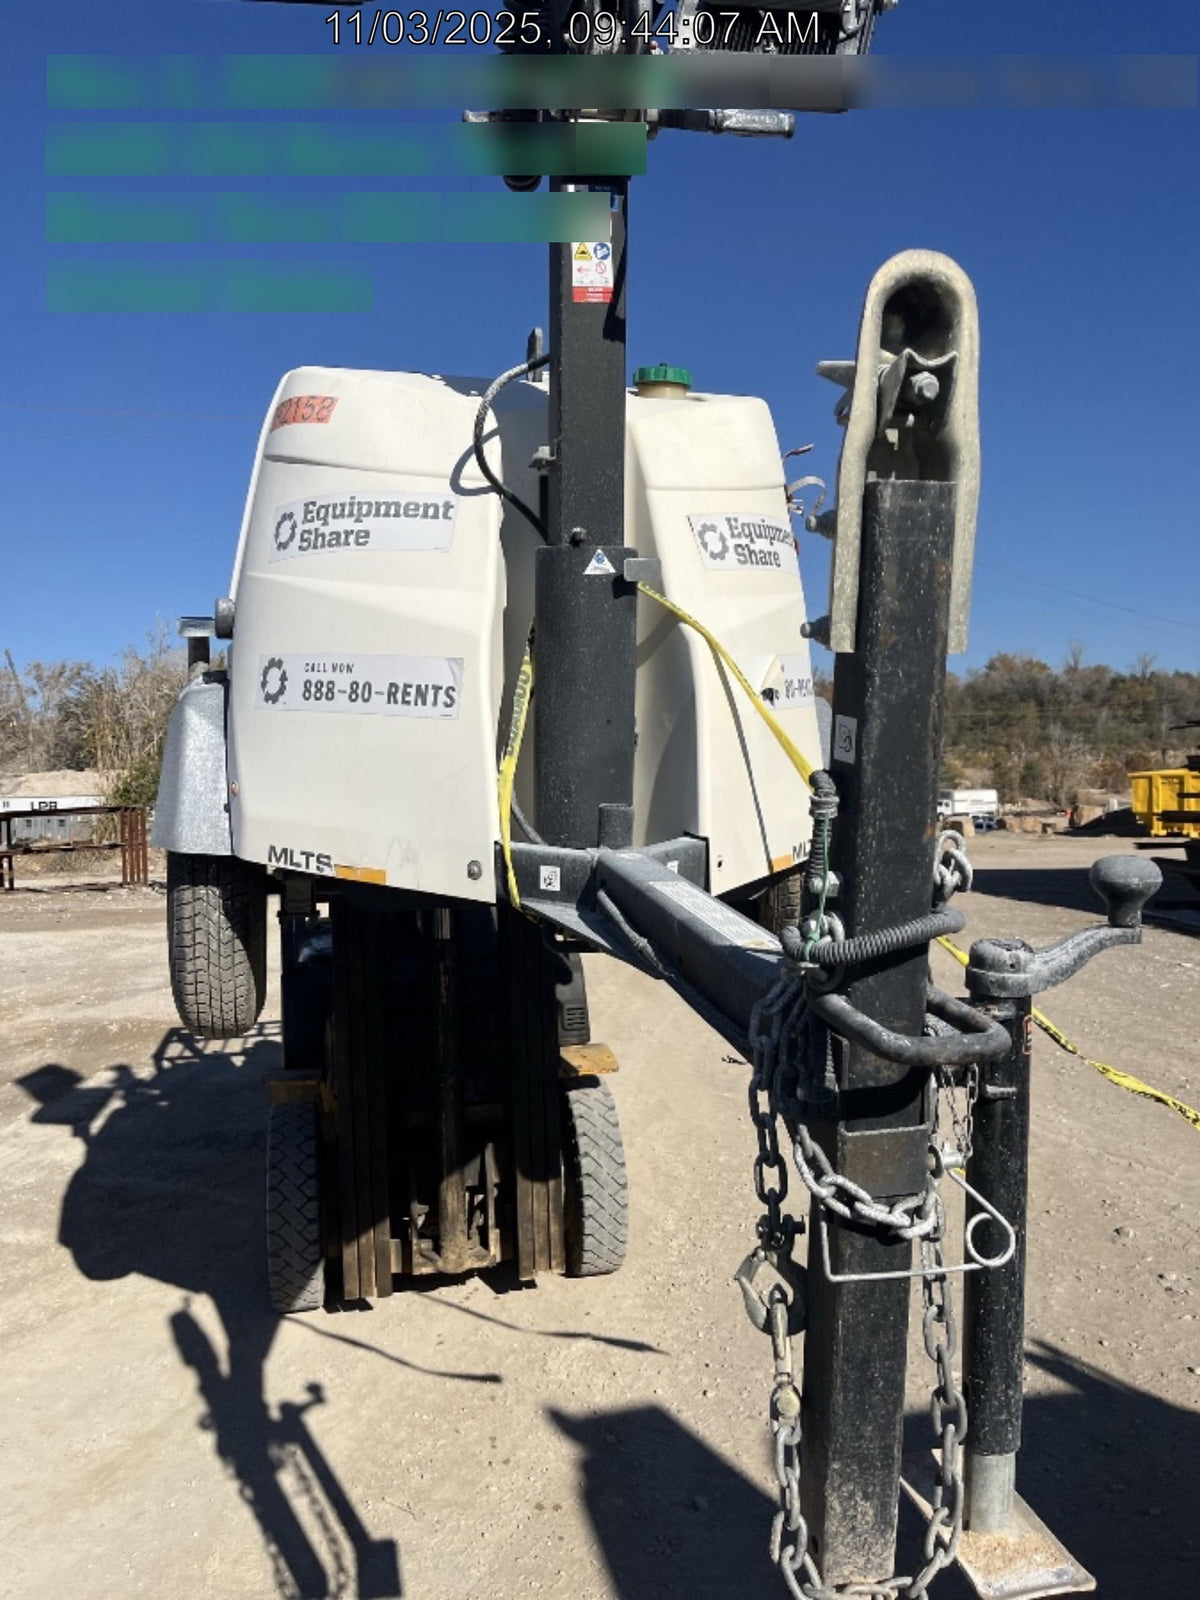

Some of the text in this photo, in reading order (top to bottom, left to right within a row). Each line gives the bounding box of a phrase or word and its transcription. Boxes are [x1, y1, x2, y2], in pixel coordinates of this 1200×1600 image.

[301, 496, 455, 526] Equipment
[298, 527, 371, 552] Share
[733, 543, 782, 568] Share
[303, 662, 355, 674] CALL NOW
[302, 678, 457, 709] 888-80-RENTS
[267, 844, 334, 873] MLTS
